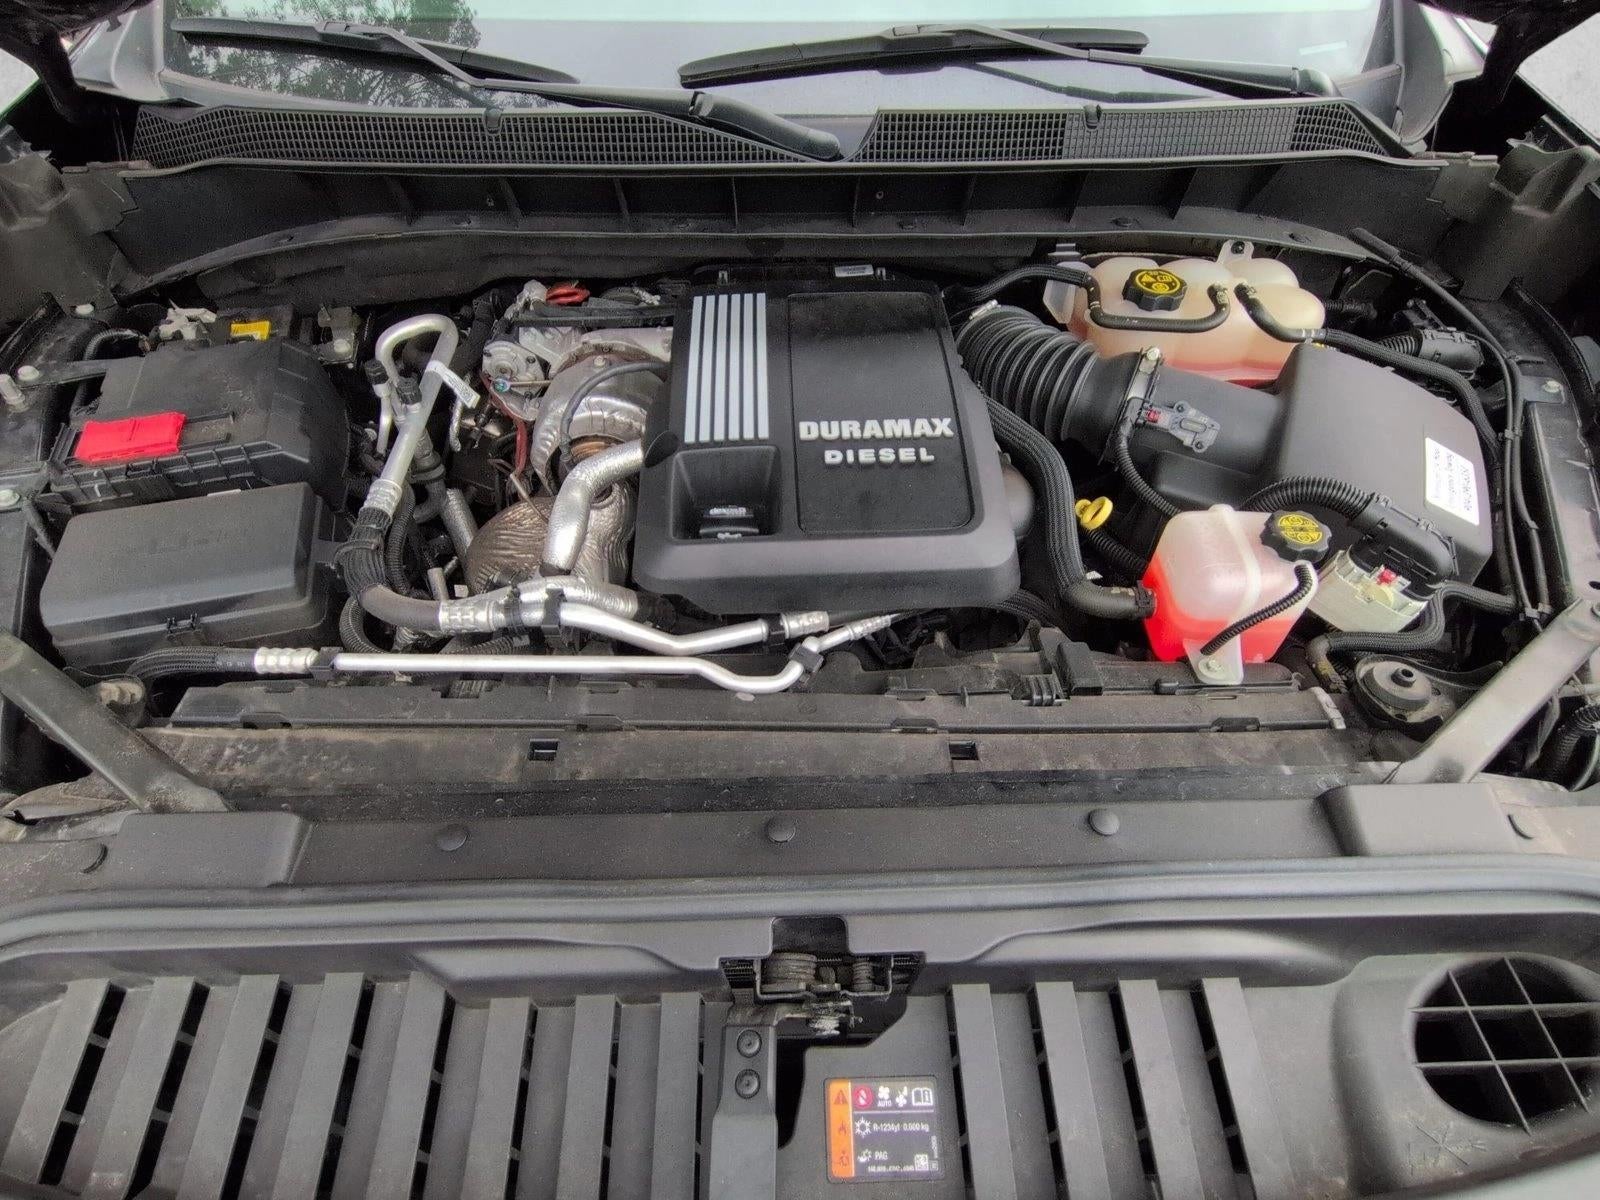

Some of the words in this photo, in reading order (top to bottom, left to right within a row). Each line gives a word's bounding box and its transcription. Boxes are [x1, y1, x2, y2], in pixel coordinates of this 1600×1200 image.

[799, 417, 954, 441] DURAMAX
[824, 447, 935, 465] DIESEL
[874, 1150, 889, 1161] PAG
